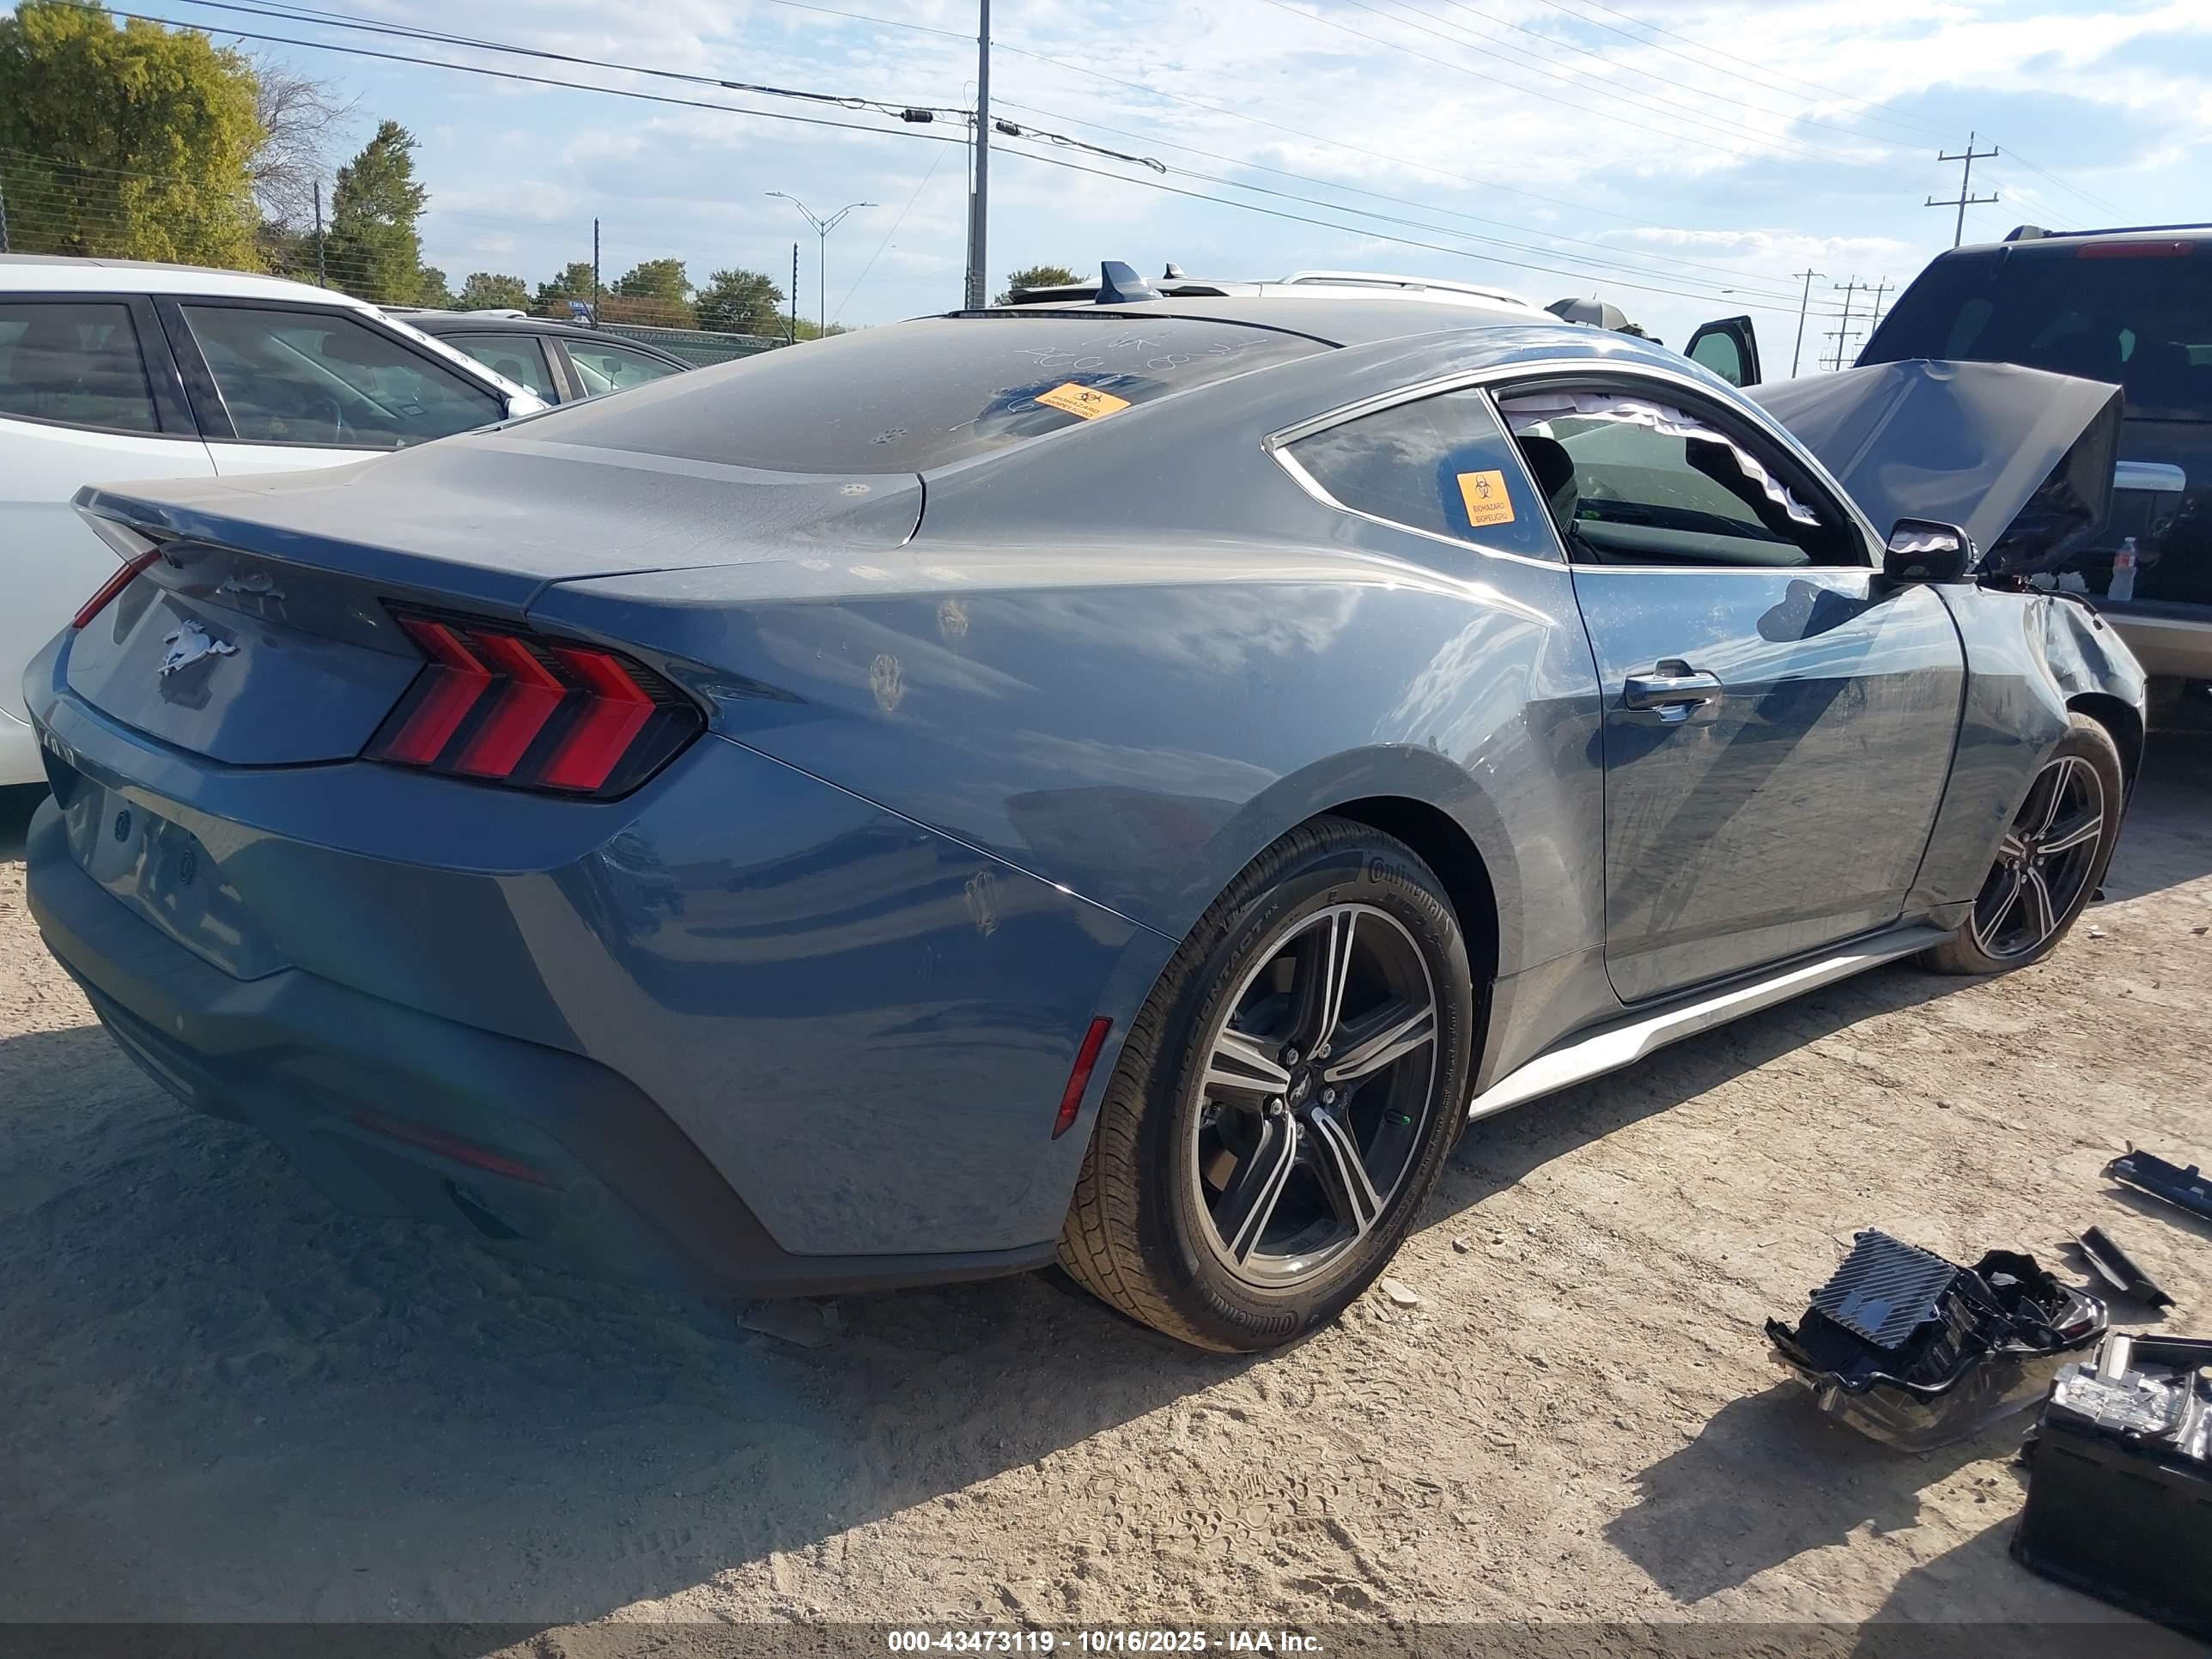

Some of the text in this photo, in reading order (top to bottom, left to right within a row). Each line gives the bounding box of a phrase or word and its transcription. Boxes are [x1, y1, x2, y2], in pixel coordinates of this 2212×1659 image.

[1044, 399, 1093, 417] BIOPELIGRO
[1051, 396, 1100, 414] BIOHAZARD
[1473, 502, 1505, 513] BIOHAZARD
[1369, 857, 1444, 921] Continental
[1207, 1291, 1299, 1338] Continental
